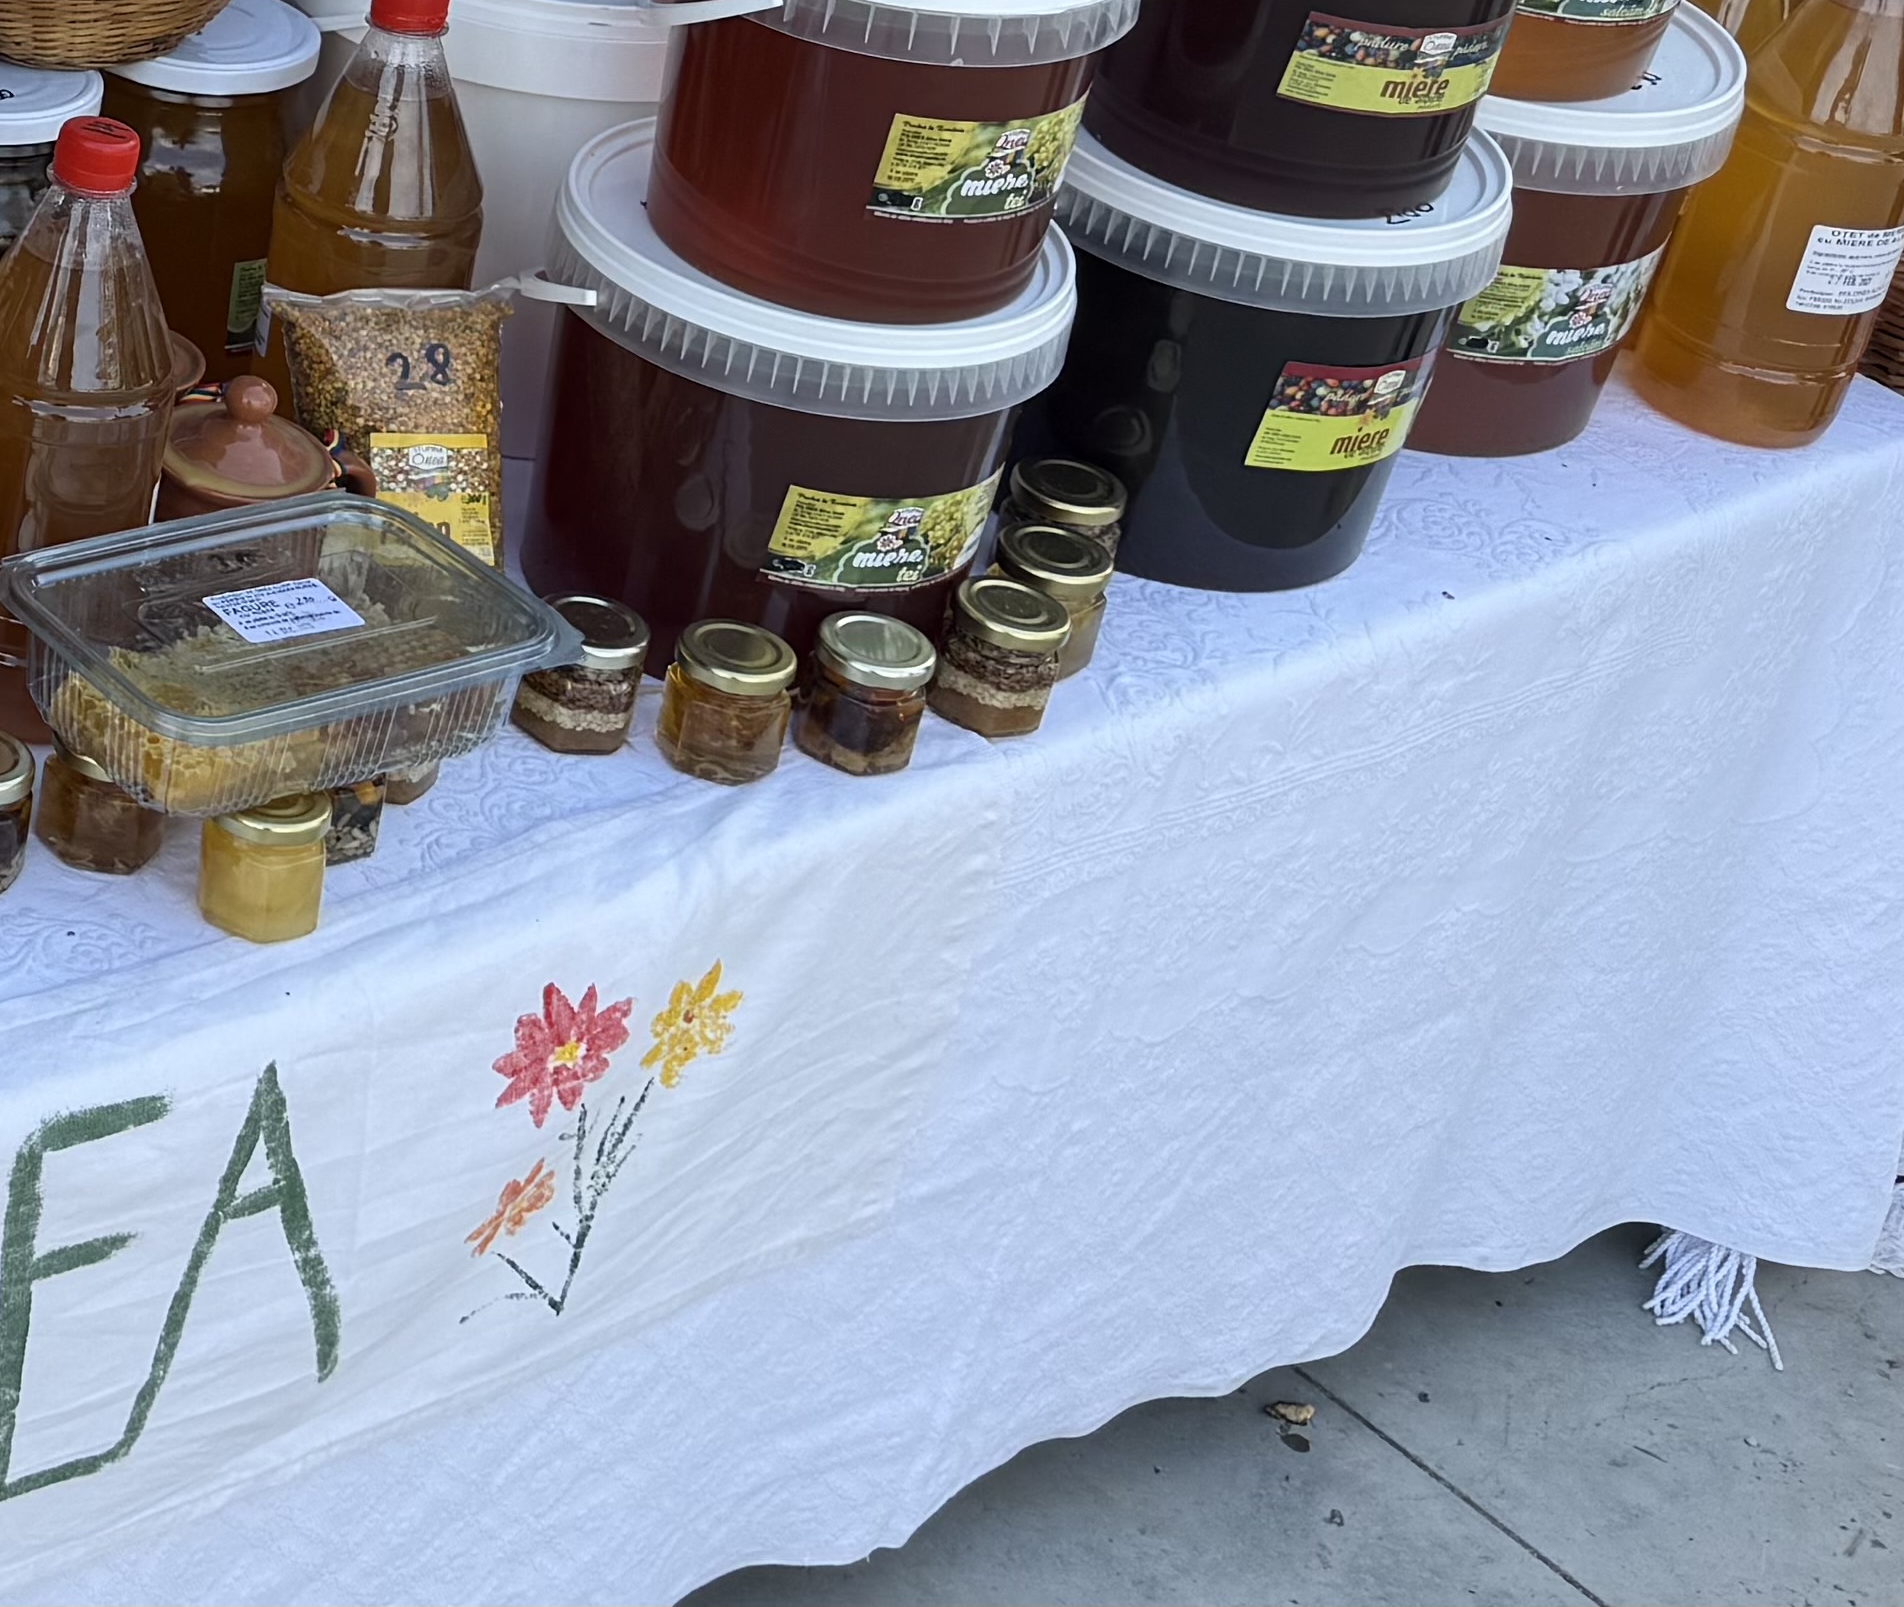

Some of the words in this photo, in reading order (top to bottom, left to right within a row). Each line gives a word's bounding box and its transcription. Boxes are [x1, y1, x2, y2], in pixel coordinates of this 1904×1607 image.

[1381, 75, 1450, 103] miere
[960, 173, 1028, 198] miere
[385, 343, 452, 392] 28
[1332, 427, 1390, 458] miere
[853, 543, 923, 568] miere
